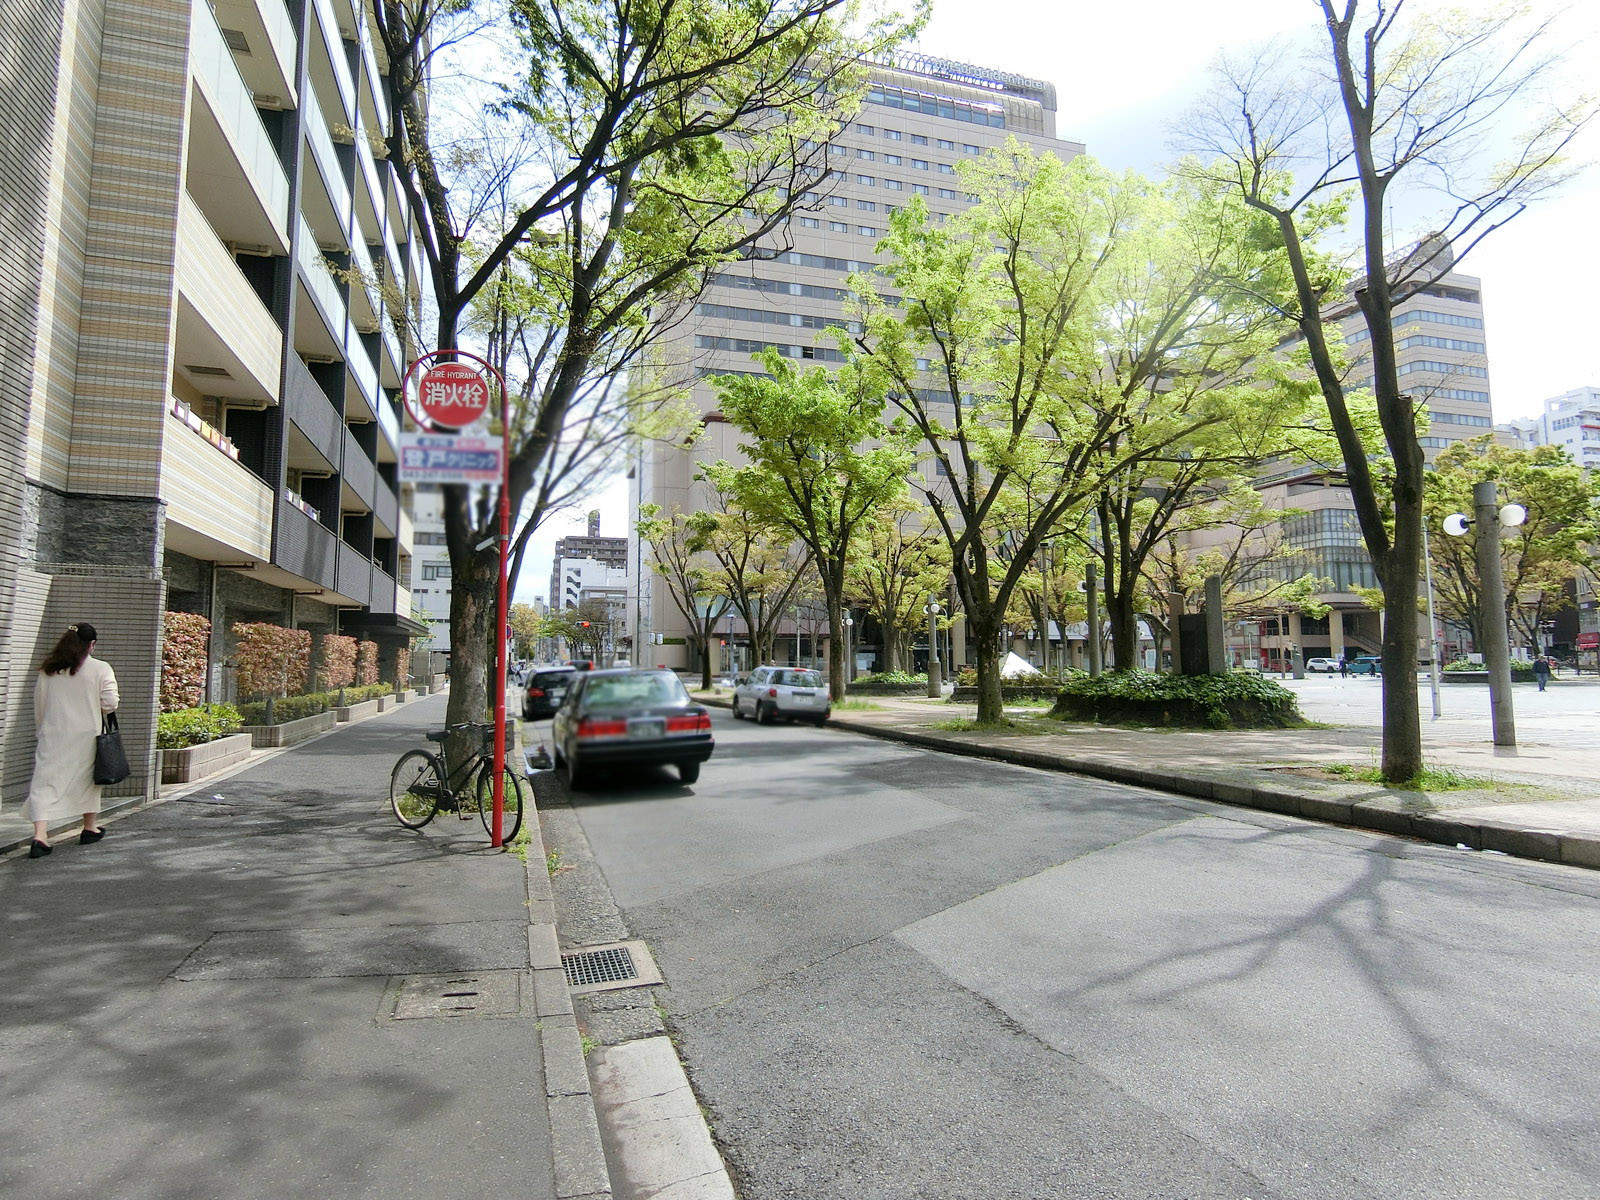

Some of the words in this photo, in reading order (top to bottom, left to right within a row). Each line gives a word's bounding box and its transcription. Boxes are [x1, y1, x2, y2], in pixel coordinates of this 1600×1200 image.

[1017, 74, 1047, 90] hotel
[447, 372, 477, 380] HYDRANT
[425, 381, 484, 408] 消火栓
